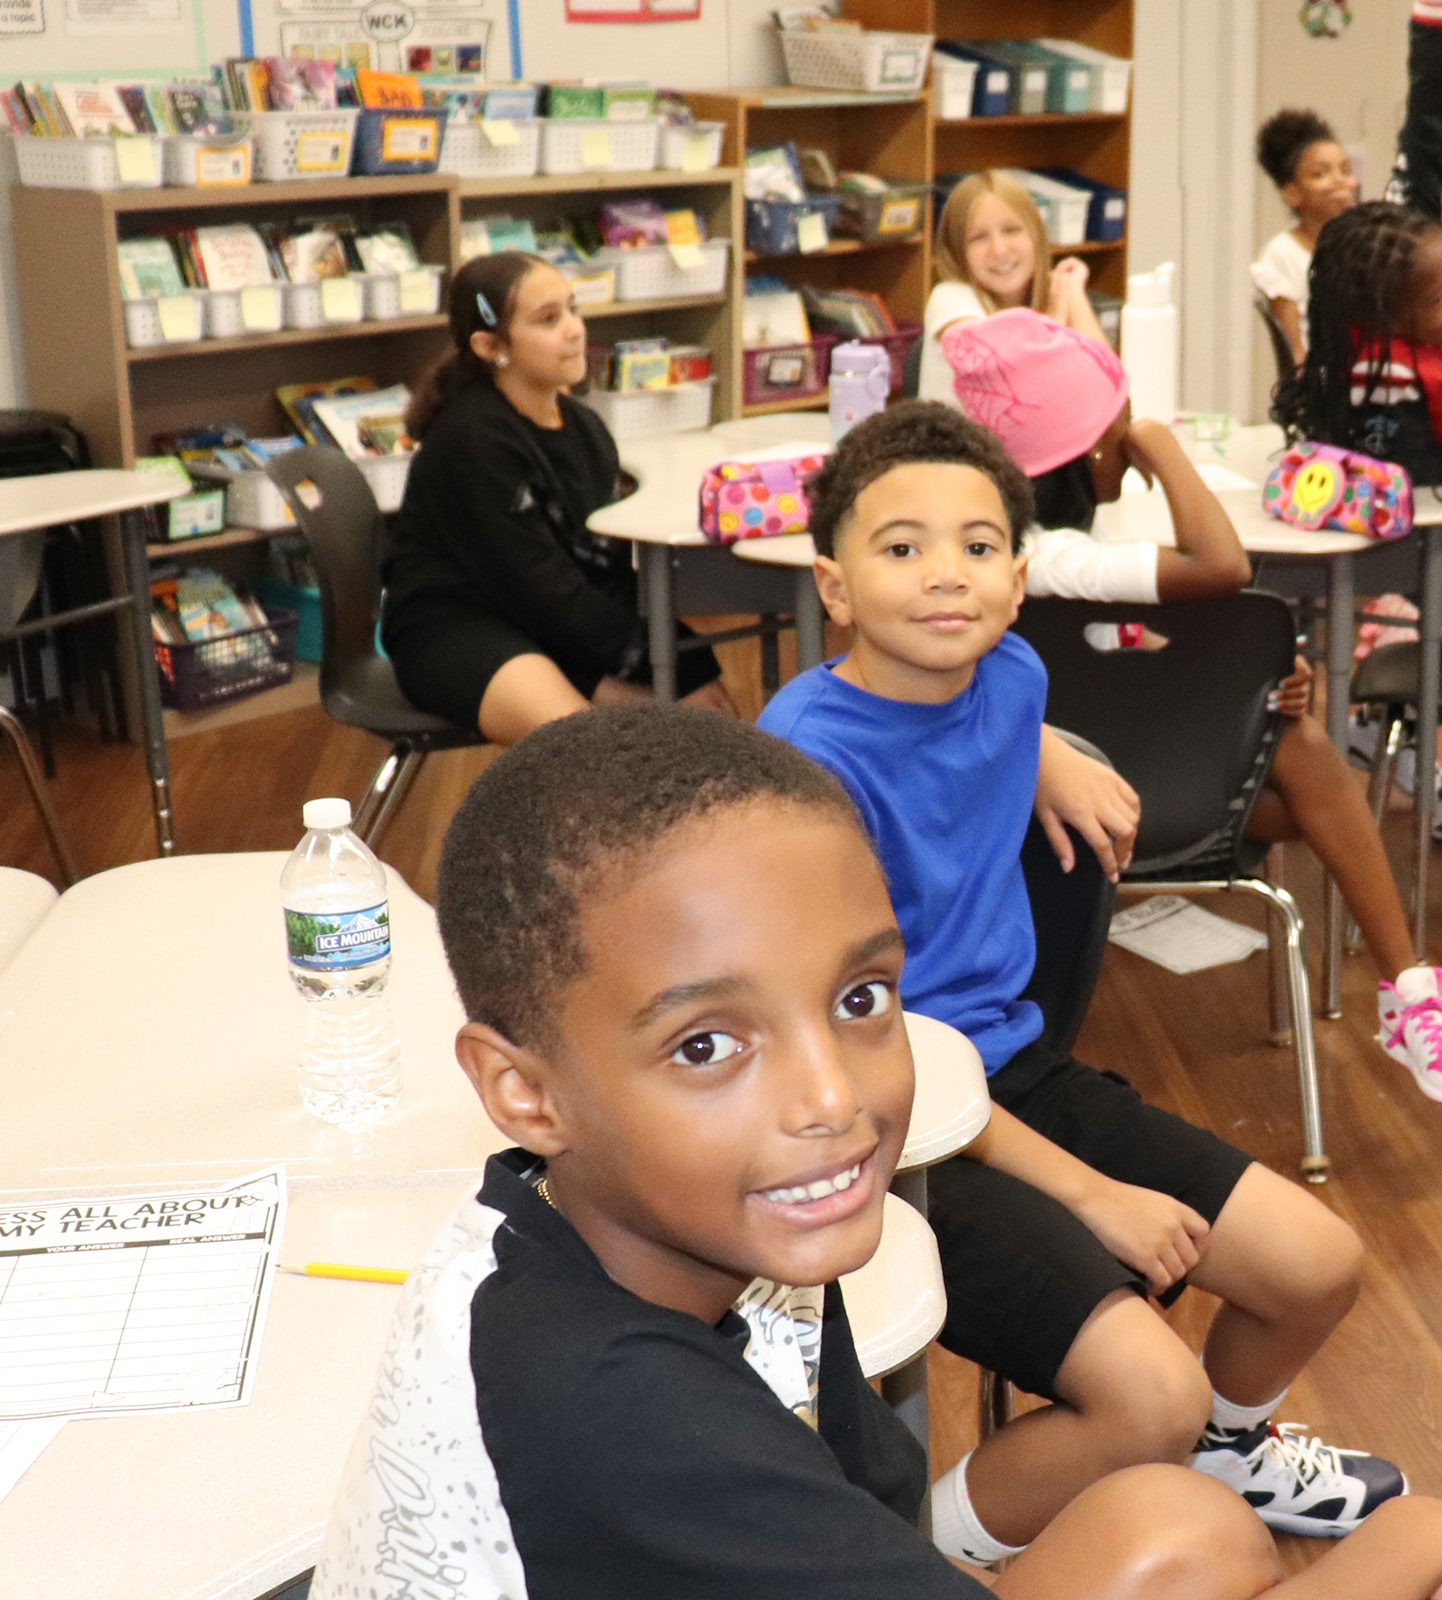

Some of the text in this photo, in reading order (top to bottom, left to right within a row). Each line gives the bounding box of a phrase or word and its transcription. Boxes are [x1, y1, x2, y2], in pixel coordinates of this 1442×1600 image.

[10, 12, 36, 24] topic
[367, 14, 408, 29] WCK
[320, 936, 339, 949] ICE
[60, 1205, 118, 1220] ALL
[133, 1195, 249, 1216] ABOUT
[59, 1212, 206, 1233] TEACHER
[169, 1233, 246, 1245] REAL ANSWER
[47, 1242, 125, 1253] YOUR ANSWER
